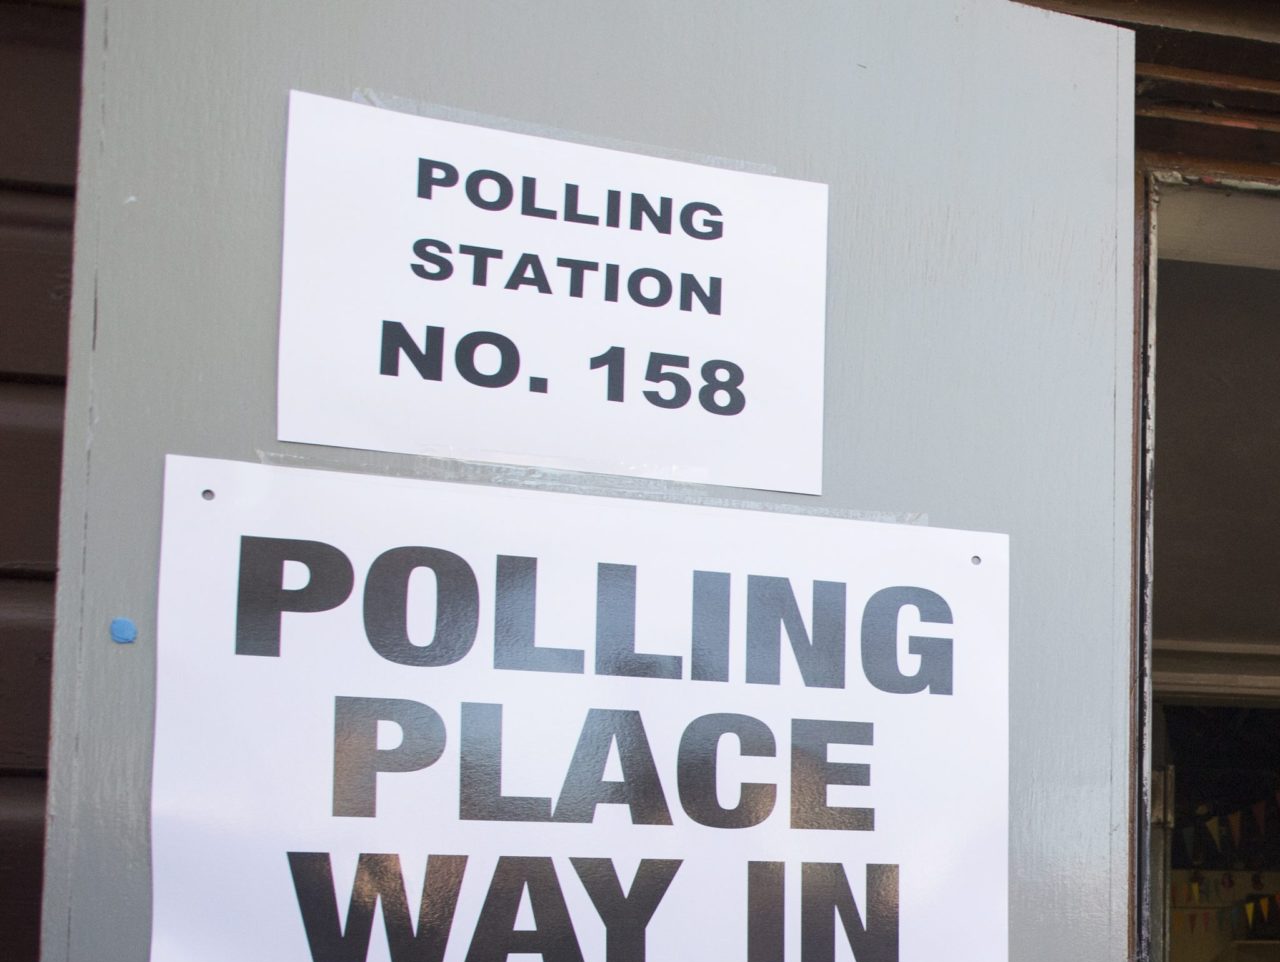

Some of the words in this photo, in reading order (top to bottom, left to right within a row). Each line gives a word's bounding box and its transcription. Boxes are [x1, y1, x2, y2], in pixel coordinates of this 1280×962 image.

[417, 157, 724, 241] POLLING
[410, 238, 722, 316] STATION
[379, 319, 549, 394] NO.
[589, 345, 747, 417] 158
[234, 534, 955, 697] POLLING
[331, 695, 876, 832] PLACE
